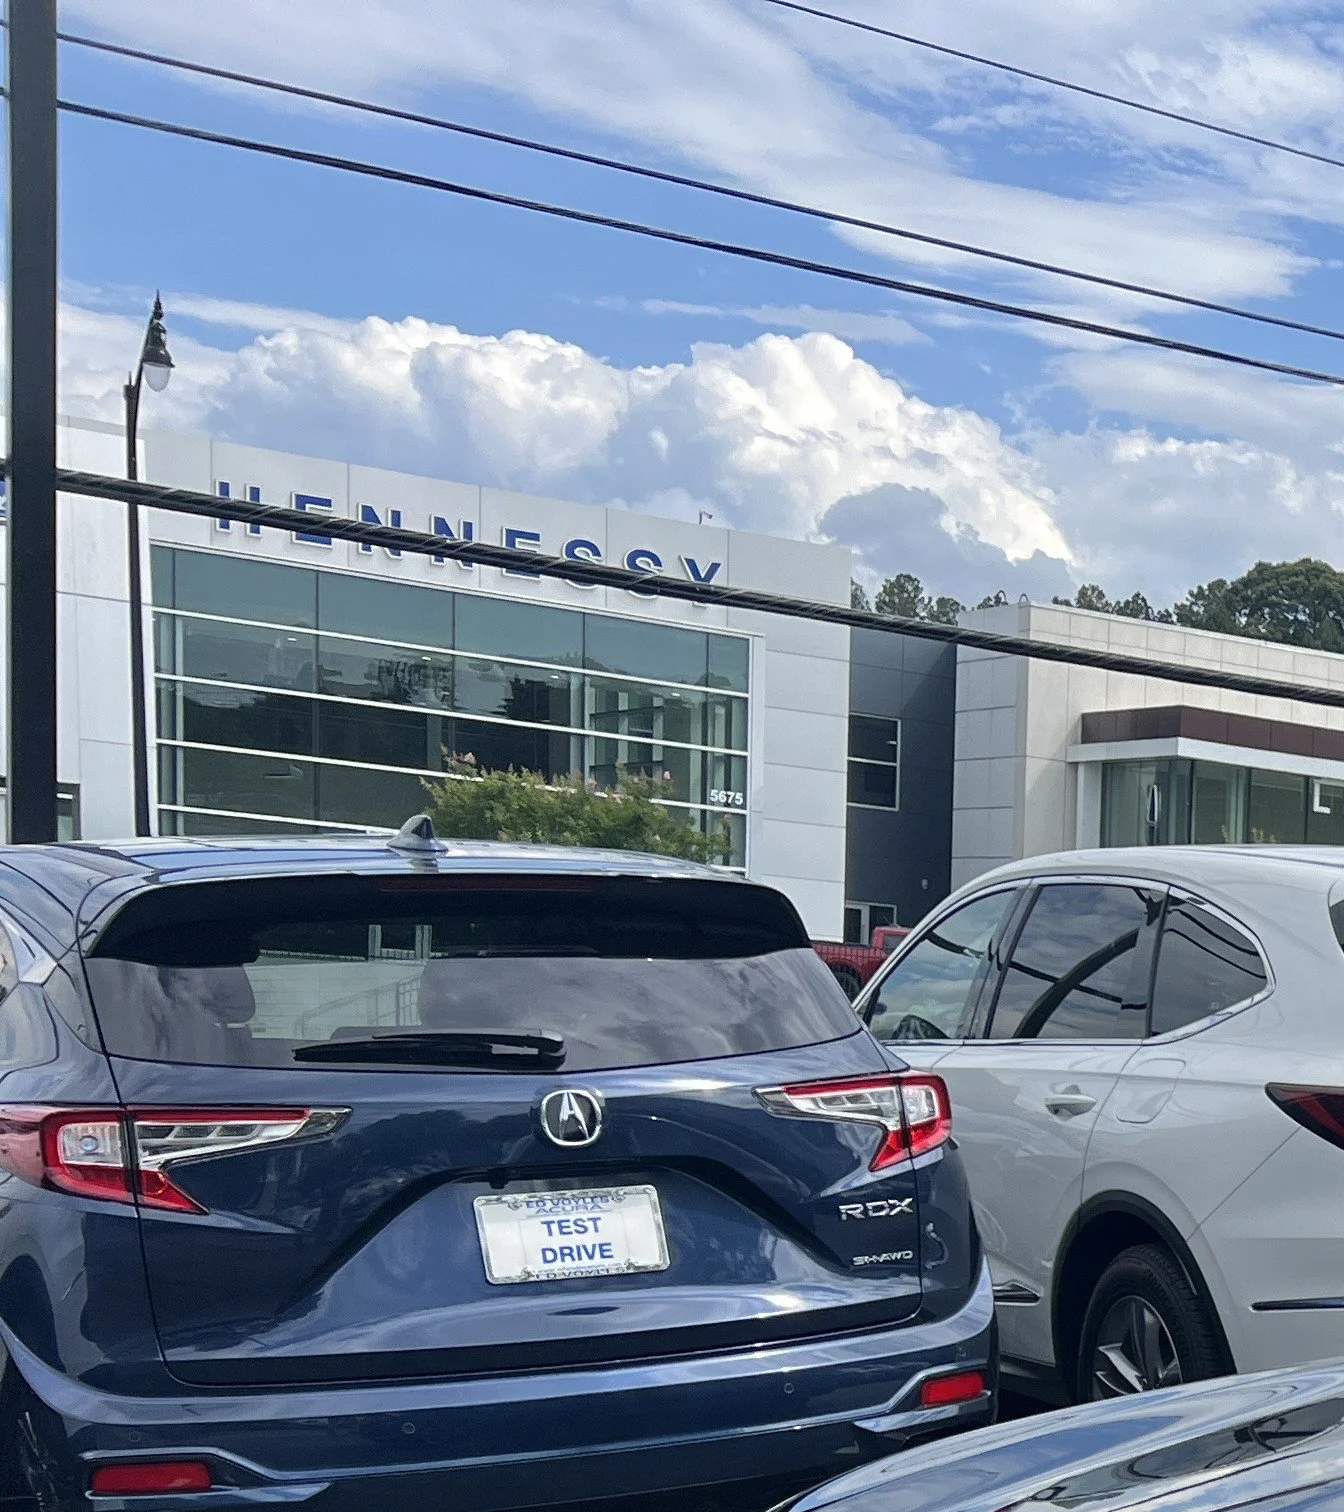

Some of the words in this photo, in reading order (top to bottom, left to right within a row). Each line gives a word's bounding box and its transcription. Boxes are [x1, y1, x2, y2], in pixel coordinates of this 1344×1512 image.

[709, 789, 744, 805] 5675
[838, 1198, 914, 1220] RDX
[540, 1216, 603, 1237] TEST
[541, 1242, 615, 1264] DRIVE
